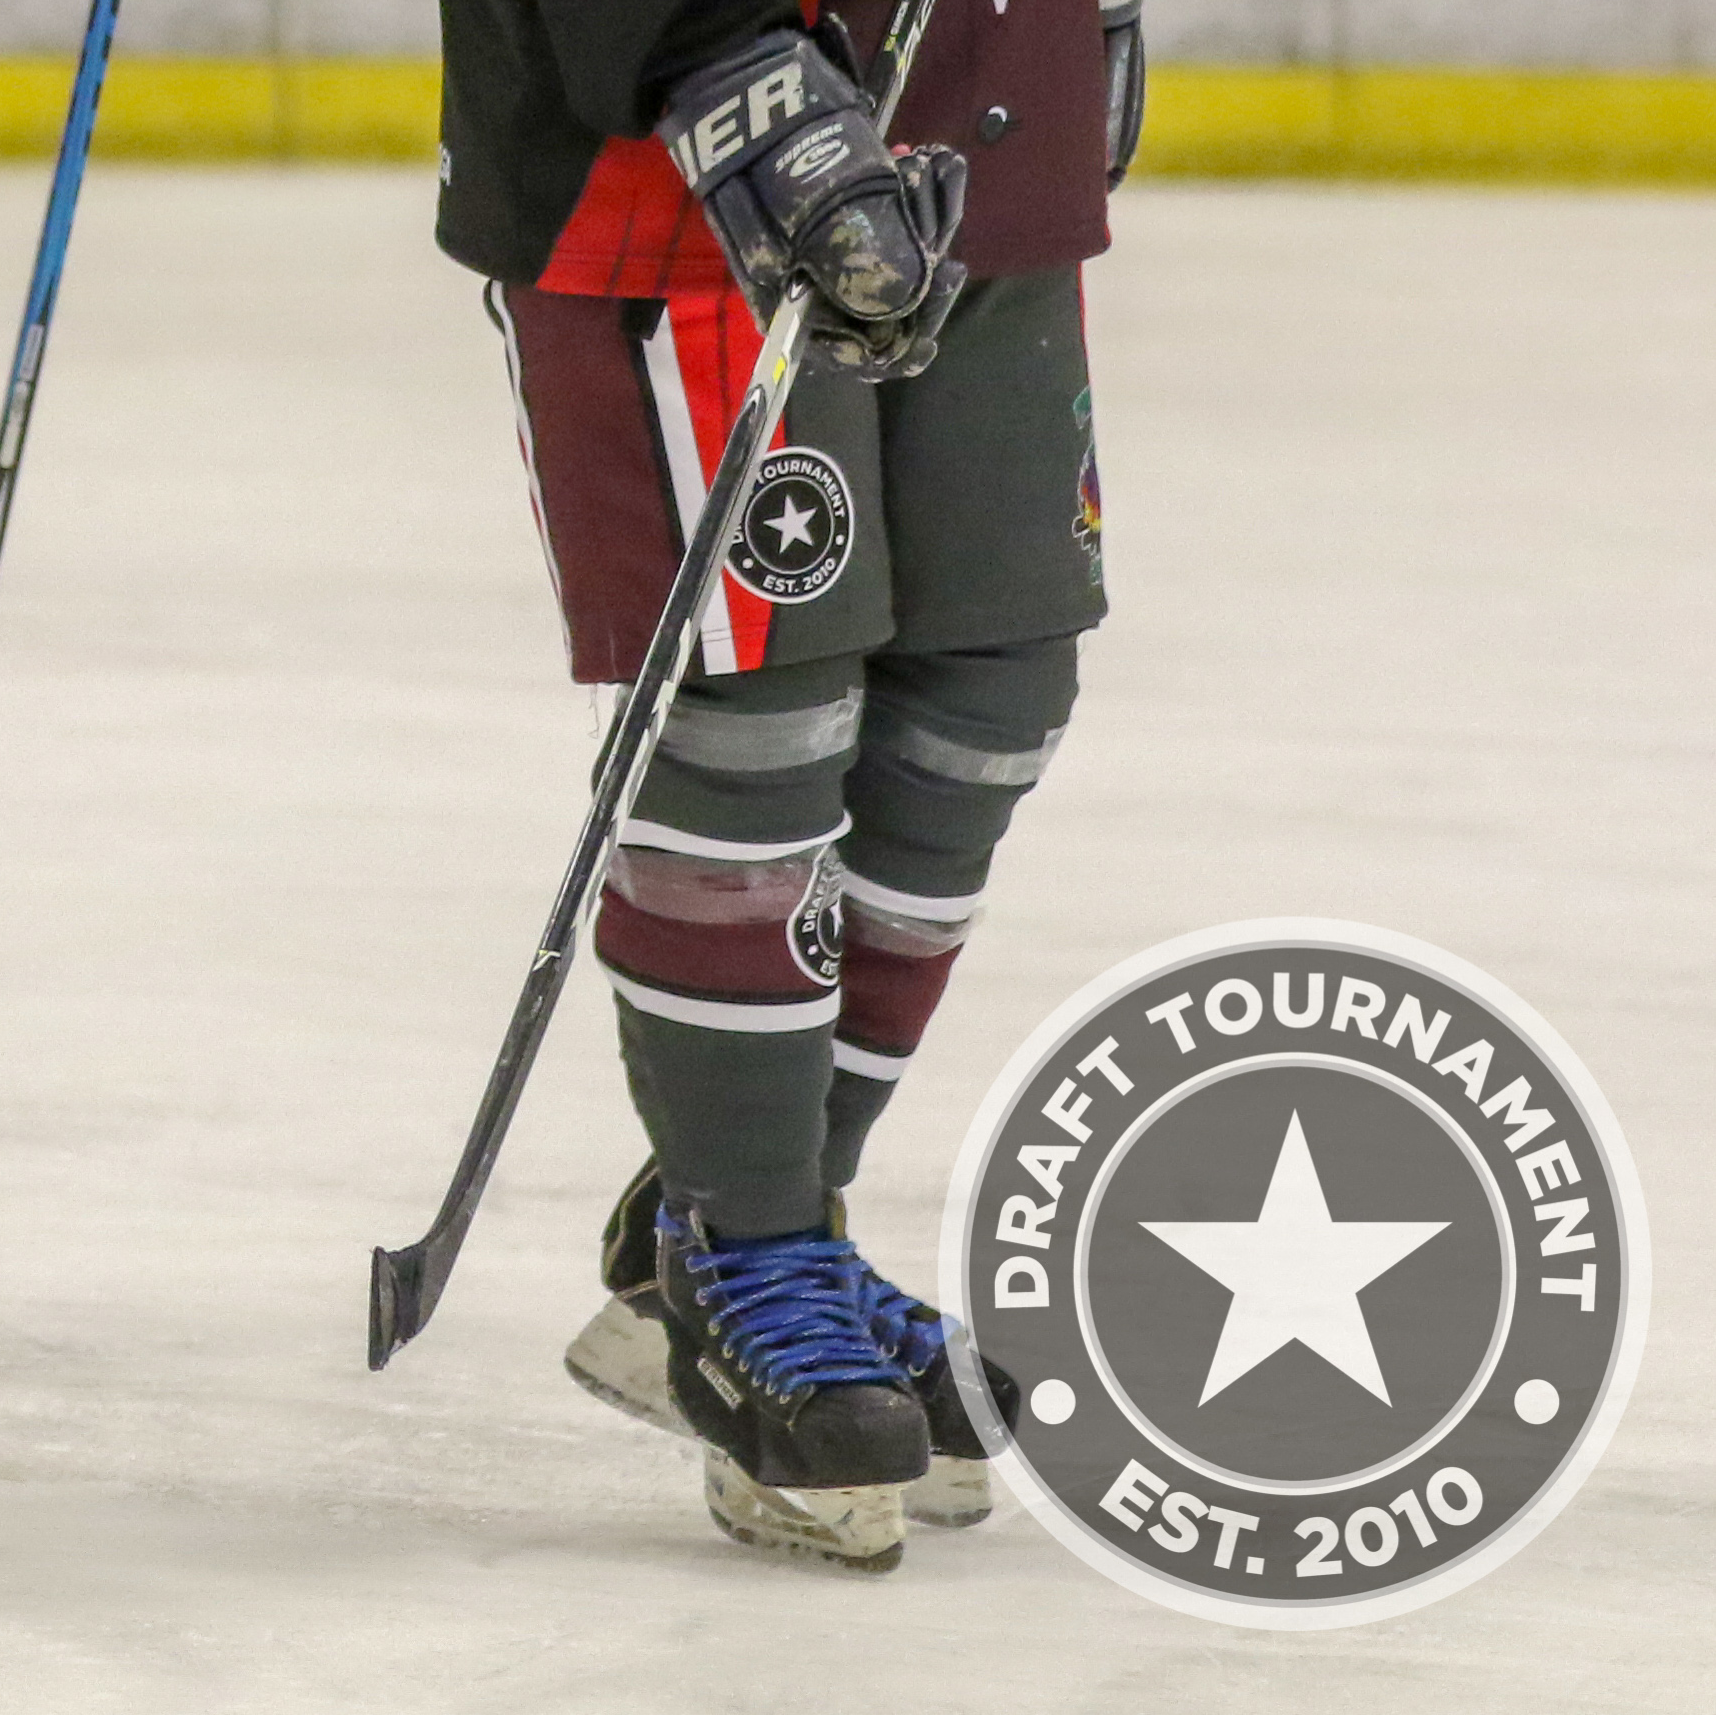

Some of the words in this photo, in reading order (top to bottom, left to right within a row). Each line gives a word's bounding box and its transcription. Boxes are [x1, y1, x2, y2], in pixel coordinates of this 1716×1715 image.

[669, 61, 805, 190] UER
[756, 459, 846, 519] TOURNAMENT
[762, 573, 801, 594] EST.
[802, 556, 837, 592] 2010
